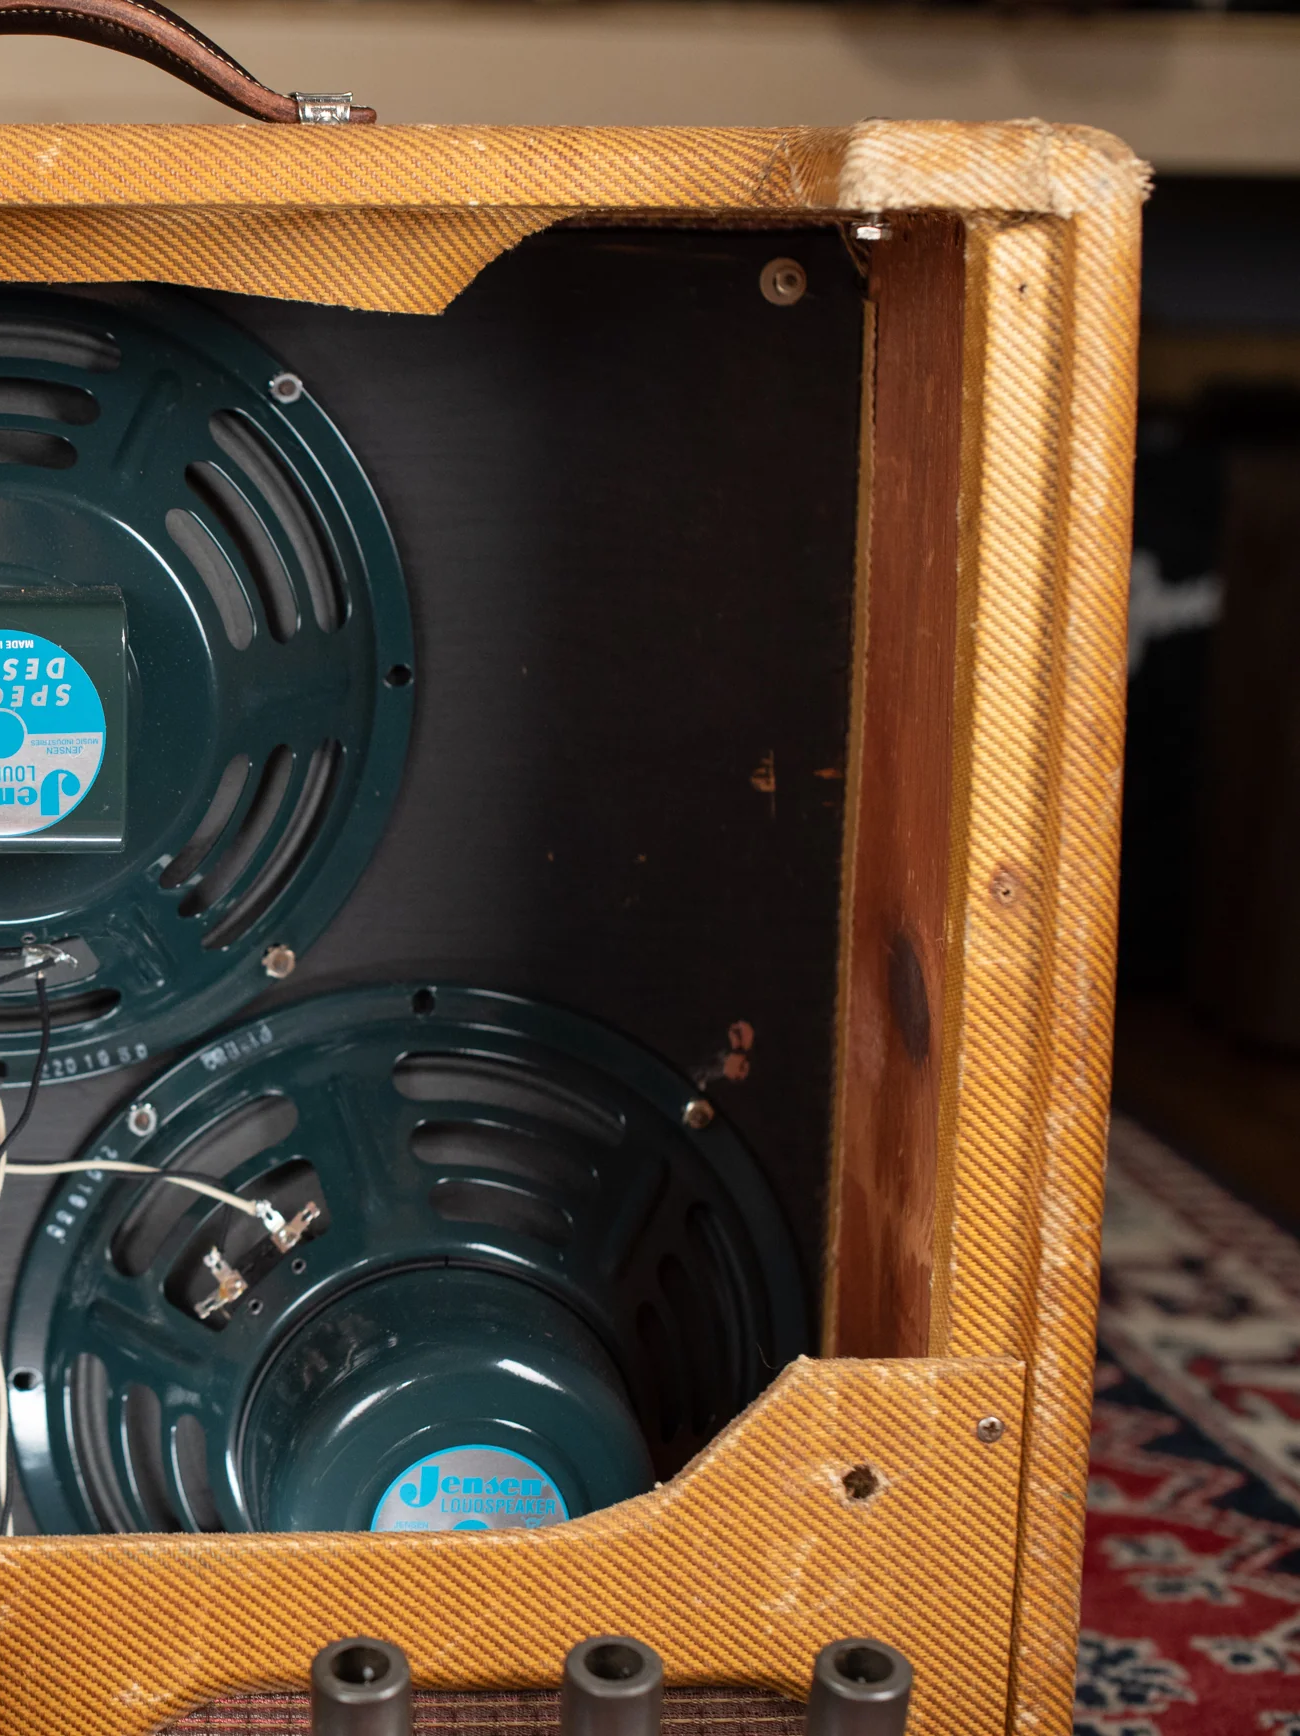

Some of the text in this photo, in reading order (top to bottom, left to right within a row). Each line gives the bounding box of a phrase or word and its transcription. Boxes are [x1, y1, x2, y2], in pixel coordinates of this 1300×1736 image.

[6, 639, 34, 649] MADE
[30, 739, 74, 747] INDUSTRIES
[46, 746, 84, 755] JENSEN
[400, 1465, 543, 1509] Jensen
[441, 1498, 556, 1515] LOUDSPEAKER
